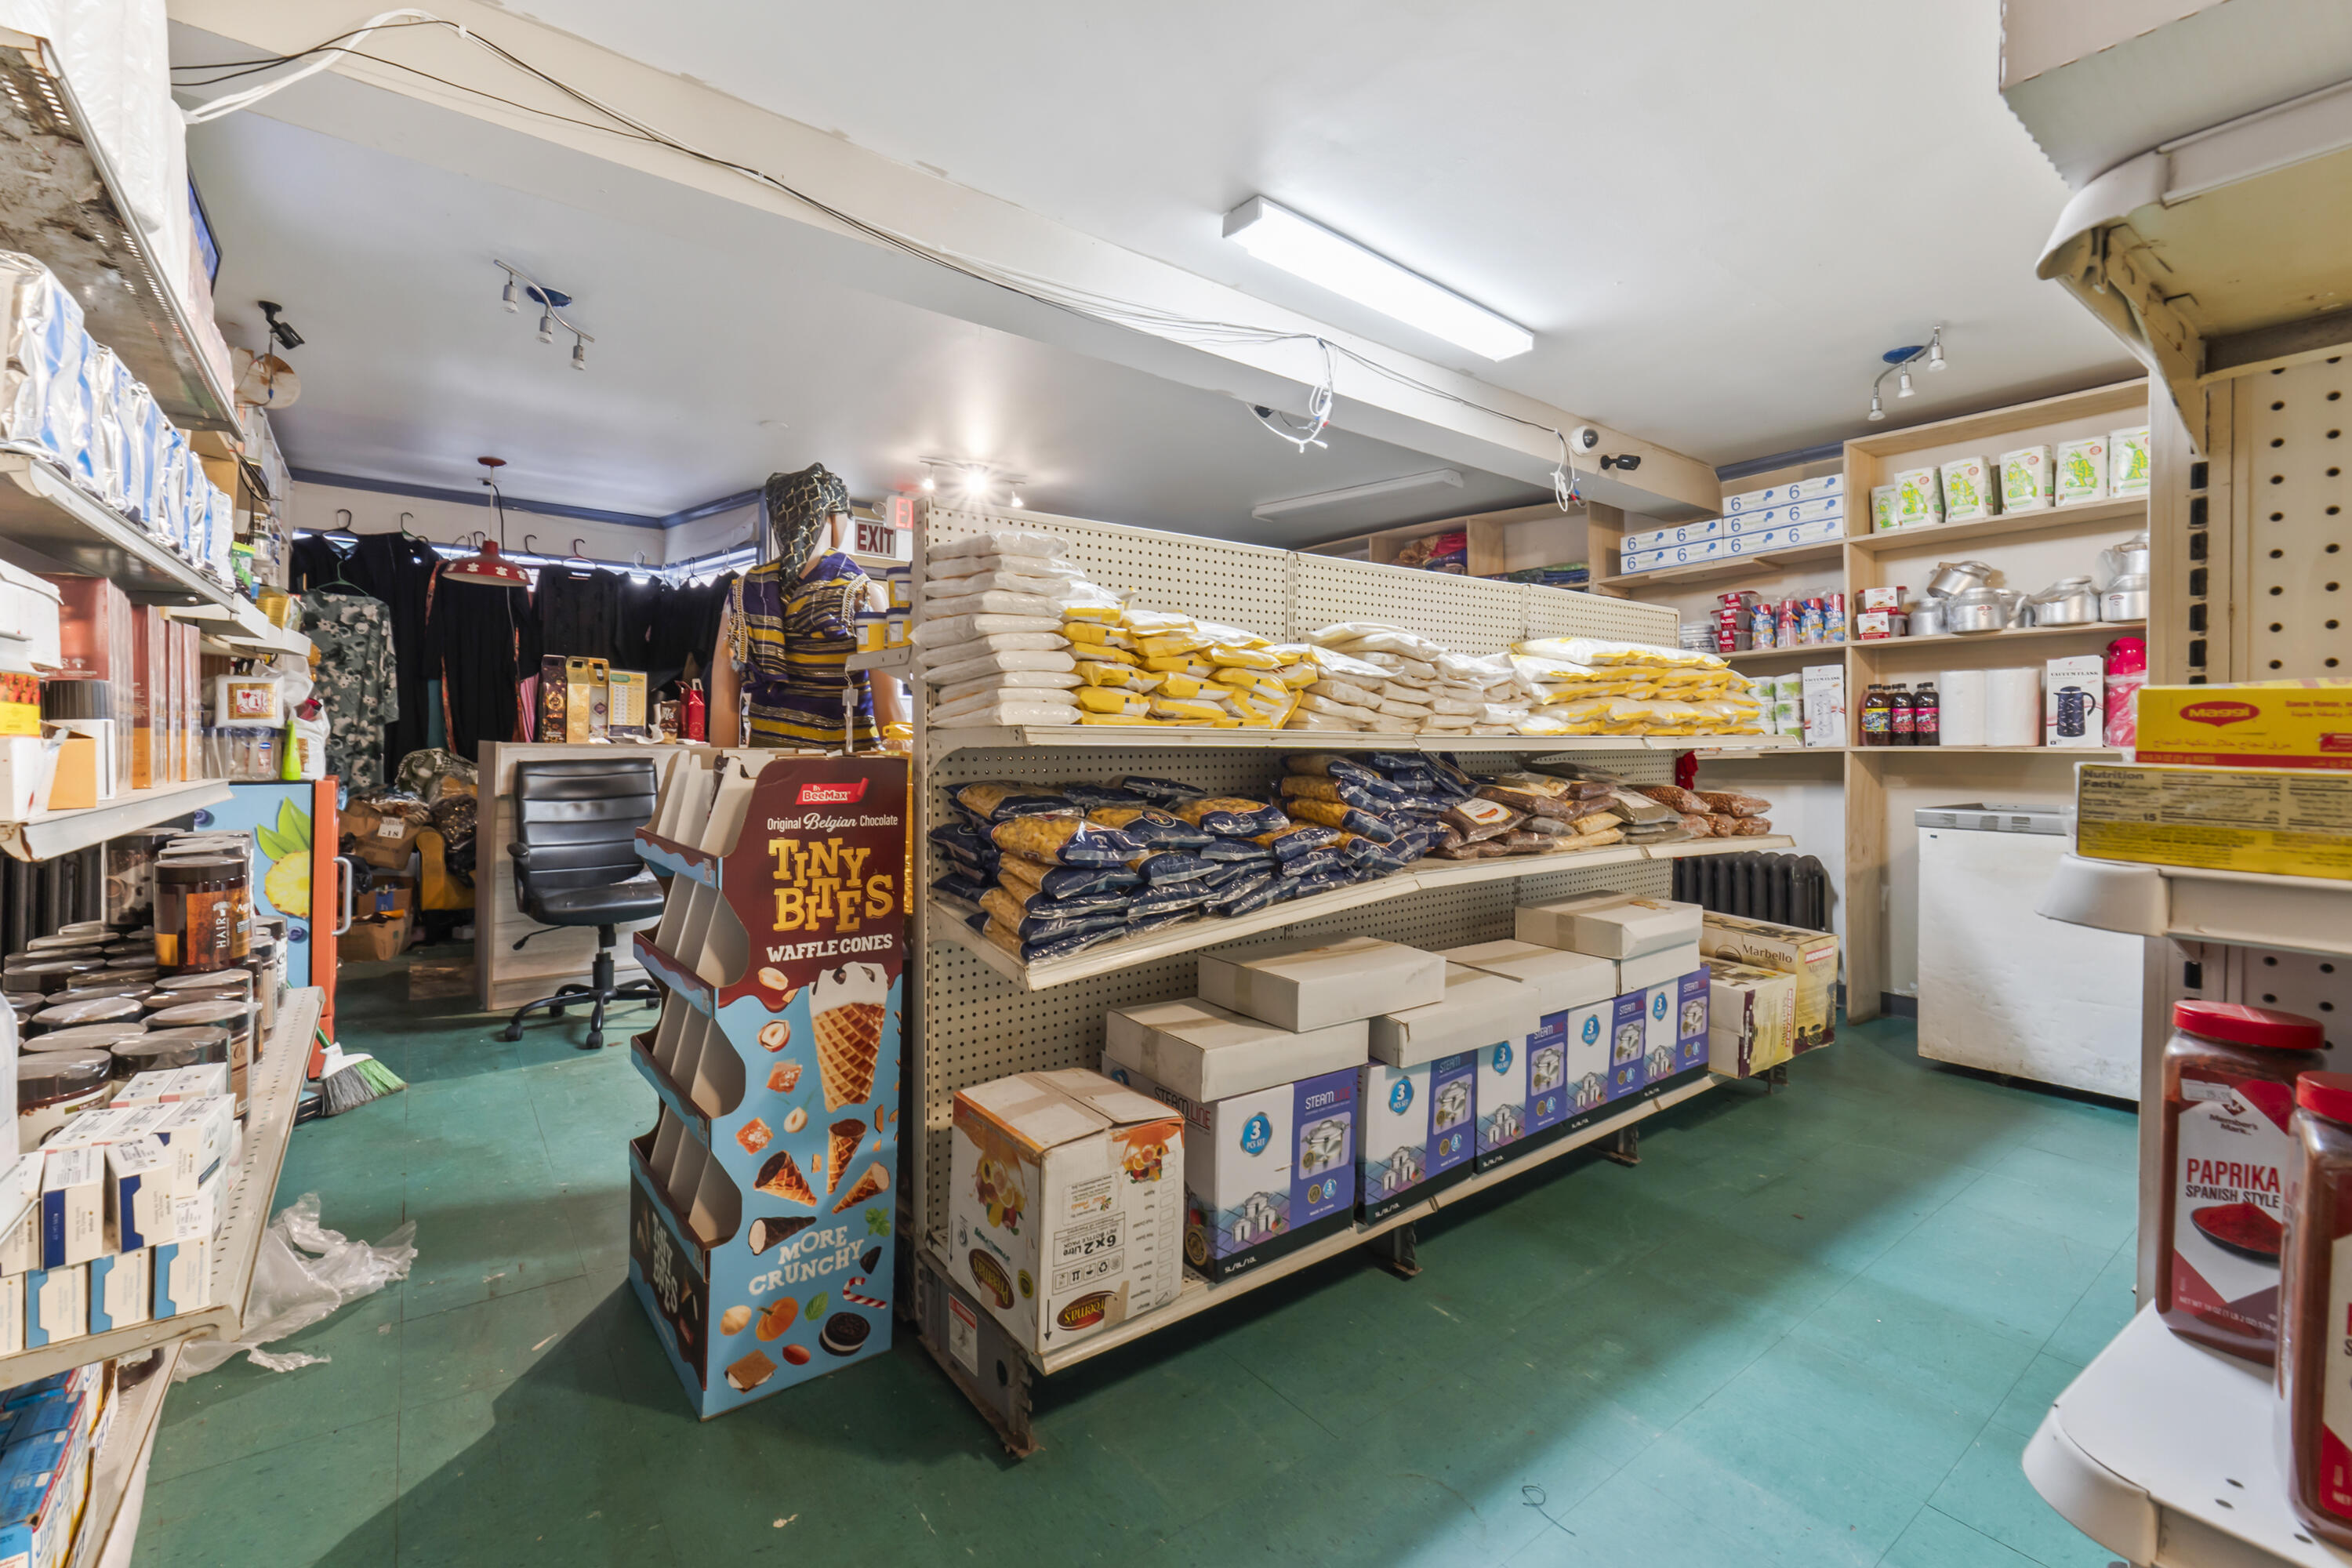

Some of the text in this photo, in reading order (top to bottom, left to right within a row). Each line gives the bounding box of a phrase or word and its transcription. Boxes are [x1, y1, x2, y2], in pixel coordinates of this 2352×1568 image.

[1789, 485, 1800, 499] 6
[1730, 497, 1740, 511] 6
[1789, 506, 1800, 521] 6
[1730, 518, 1740, 532] 6
[858, 524, 894, 554] EXIT
[1677, 528, 1686, 542] 6
[1789, 528, 1800, 543] 6
[1628, 537, 1636, 550] 6
[1730, 539, 1740, 553] 6
[1678, 548, 1686, 561] 6
[1628, 557, 1636, 569] 6
[2188, 707, 2251, 718] Maggi
[2083, 770, 2144, 779] Nutrition
[802, 790, 848, 801] BeeMax
[767, 812, 898, 833] Original Belgian Chocolate
[2143, 813, 2157, 822] 15
[768, 837, 870, 889] TINY
[772, 874, 895, 934] BITES
[216, 918, 227, 949] HAIR
[766, 934, 894, 963] WAFFLE CONES
[1743, 944, 1793, 964] Marbello
[1657, 998, 1663, 1010] 3
[1587, 1021, 1594, 1033] 3
[1498, 1047, 1506, 1062] 3
[1396, 1083, 1406, 1101] 3
[2209, 1114, 2259, 1131] Member's
[1250, 1120, 1261, 1140] 3
[1247, 1138, 1265, 1149] PCS SET
[2187, 1158, 2281, 1193] PAPRIKA
[1327, 1181, 1333, 1191] 3
[2186, 1185, 2280, 1208] SPANISH STYLE
[1063, 1240, 1080, 1248] PACK
[1081, 1232, 1105, 1243] BOTTLE
[779, 1225, 848, 1265] MORE
[1062, 1245, 1082, 1256] Litre
[748, 1239, 866, 1296] CRUNCHY
[1064, 1299, 1106, 1325] reema's
